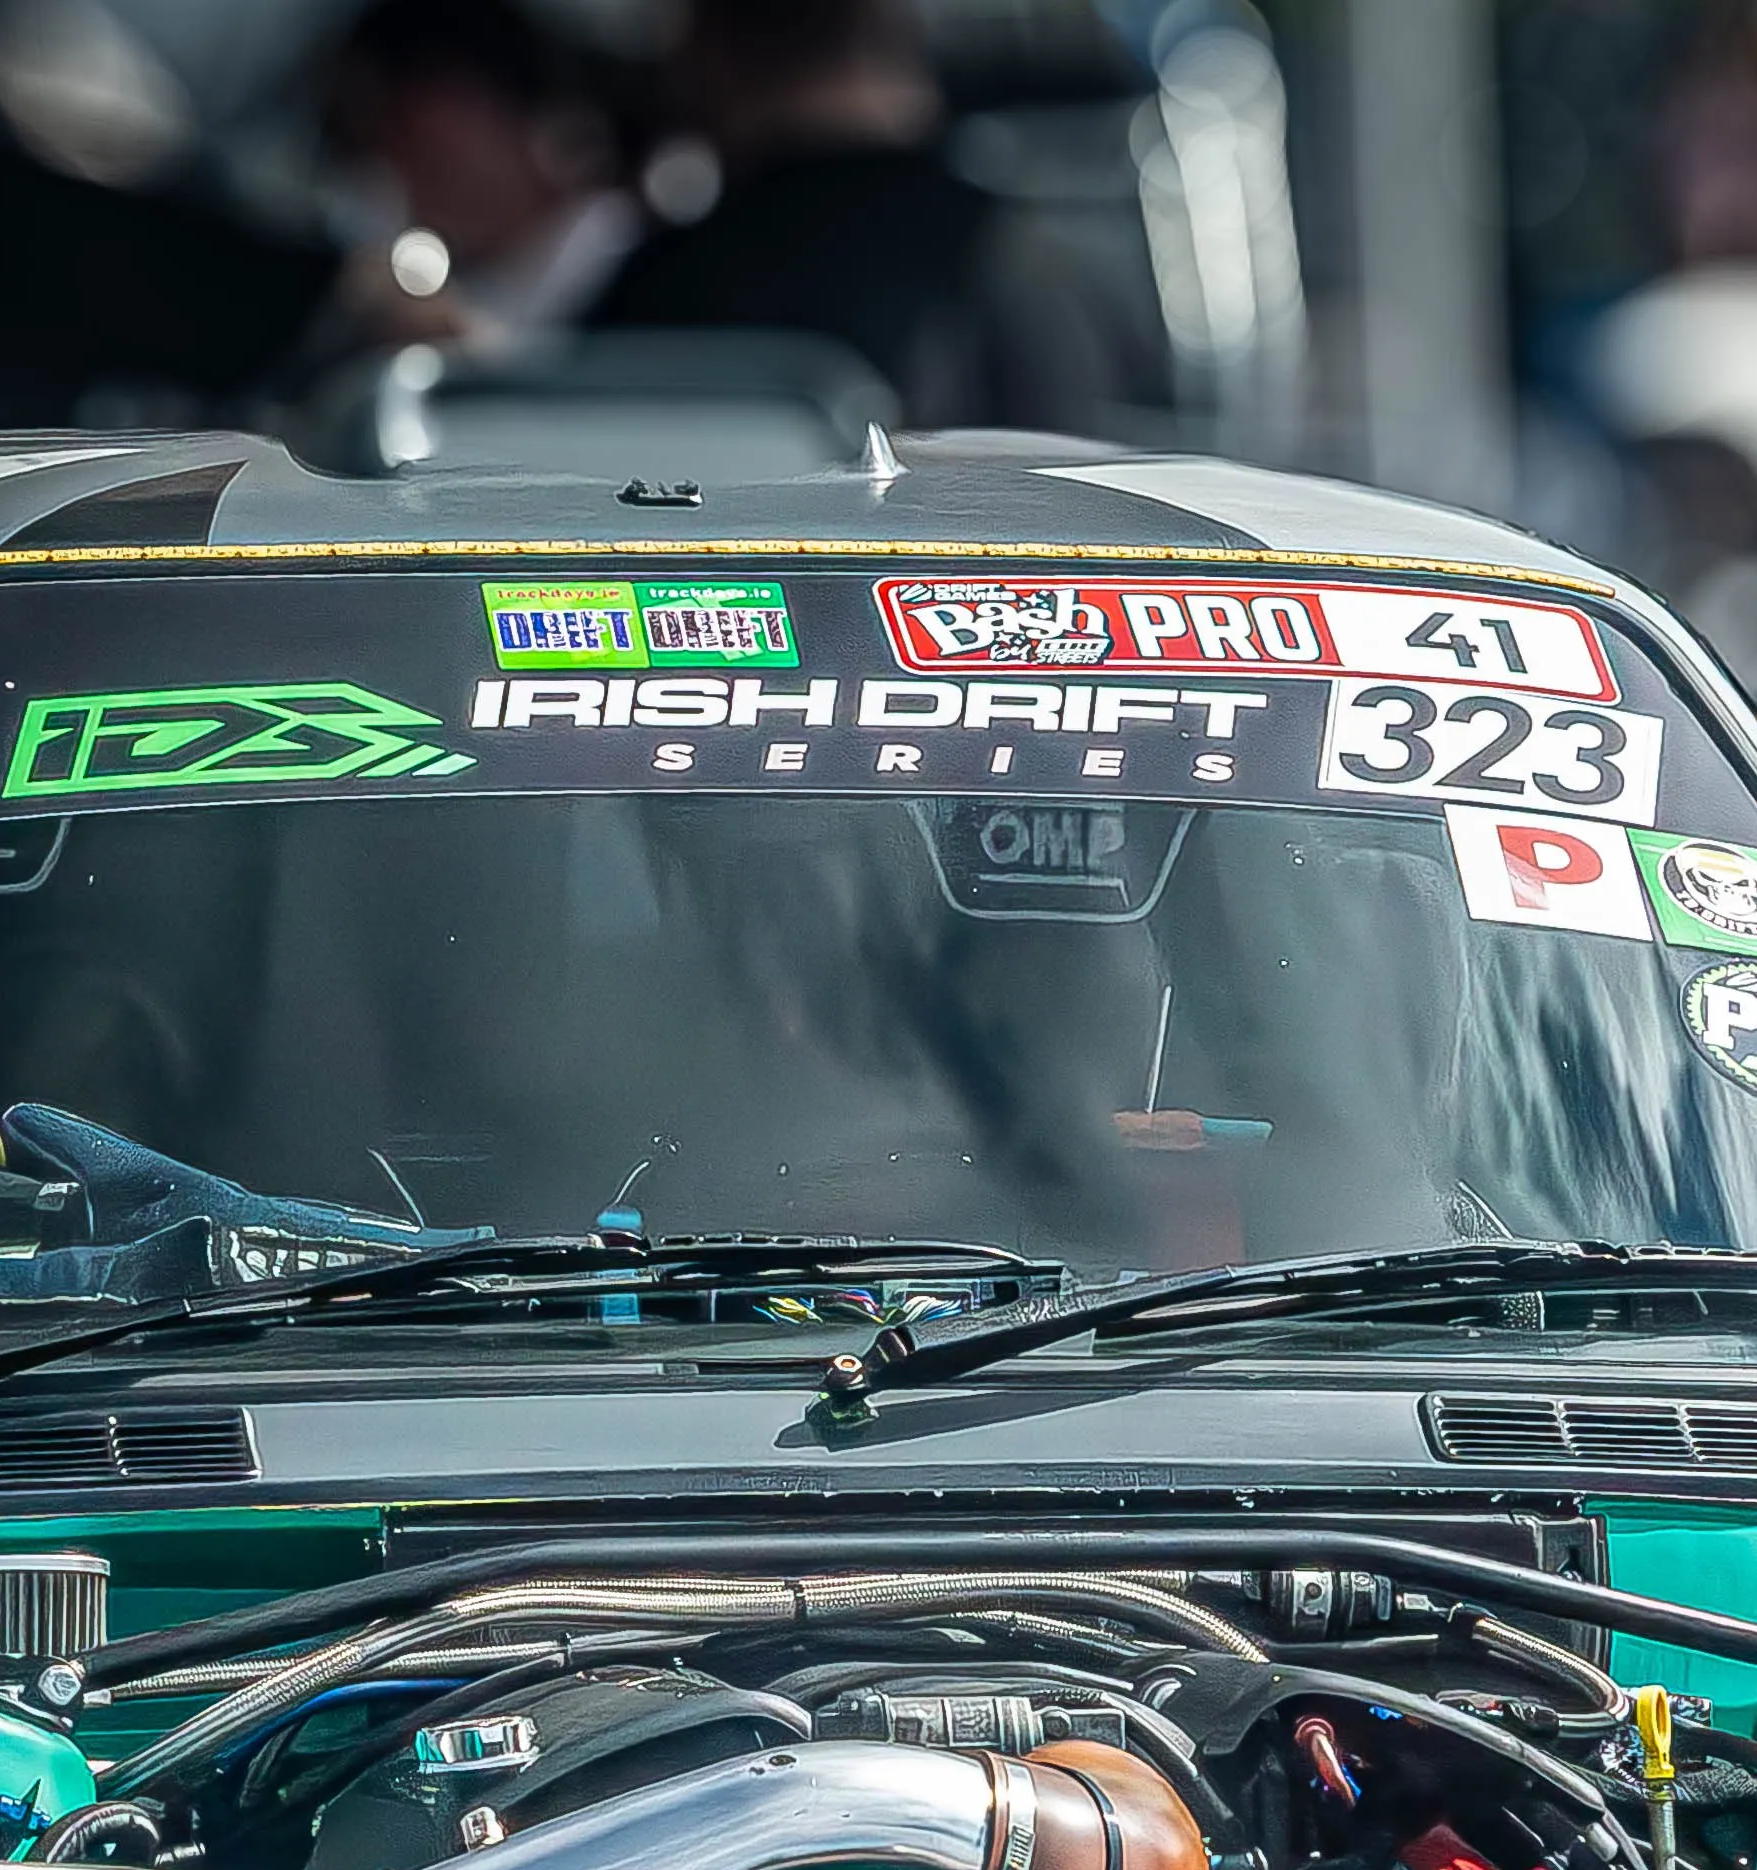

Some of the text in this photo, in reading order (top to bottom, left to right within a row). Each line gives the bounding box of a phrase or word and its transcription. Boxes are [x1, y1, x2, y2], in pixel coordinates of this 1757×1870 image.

[907, 588, 1529, 674] Bash PRO 41
[470, 677, 1269, 739] IRISH DRIFT
[652, 741, 1238, 783] SERIES
[1339, 686, 1627, 806] 323
[980, 810, 1126, 868] OMP
[1496, 825, 1604, 910] P
